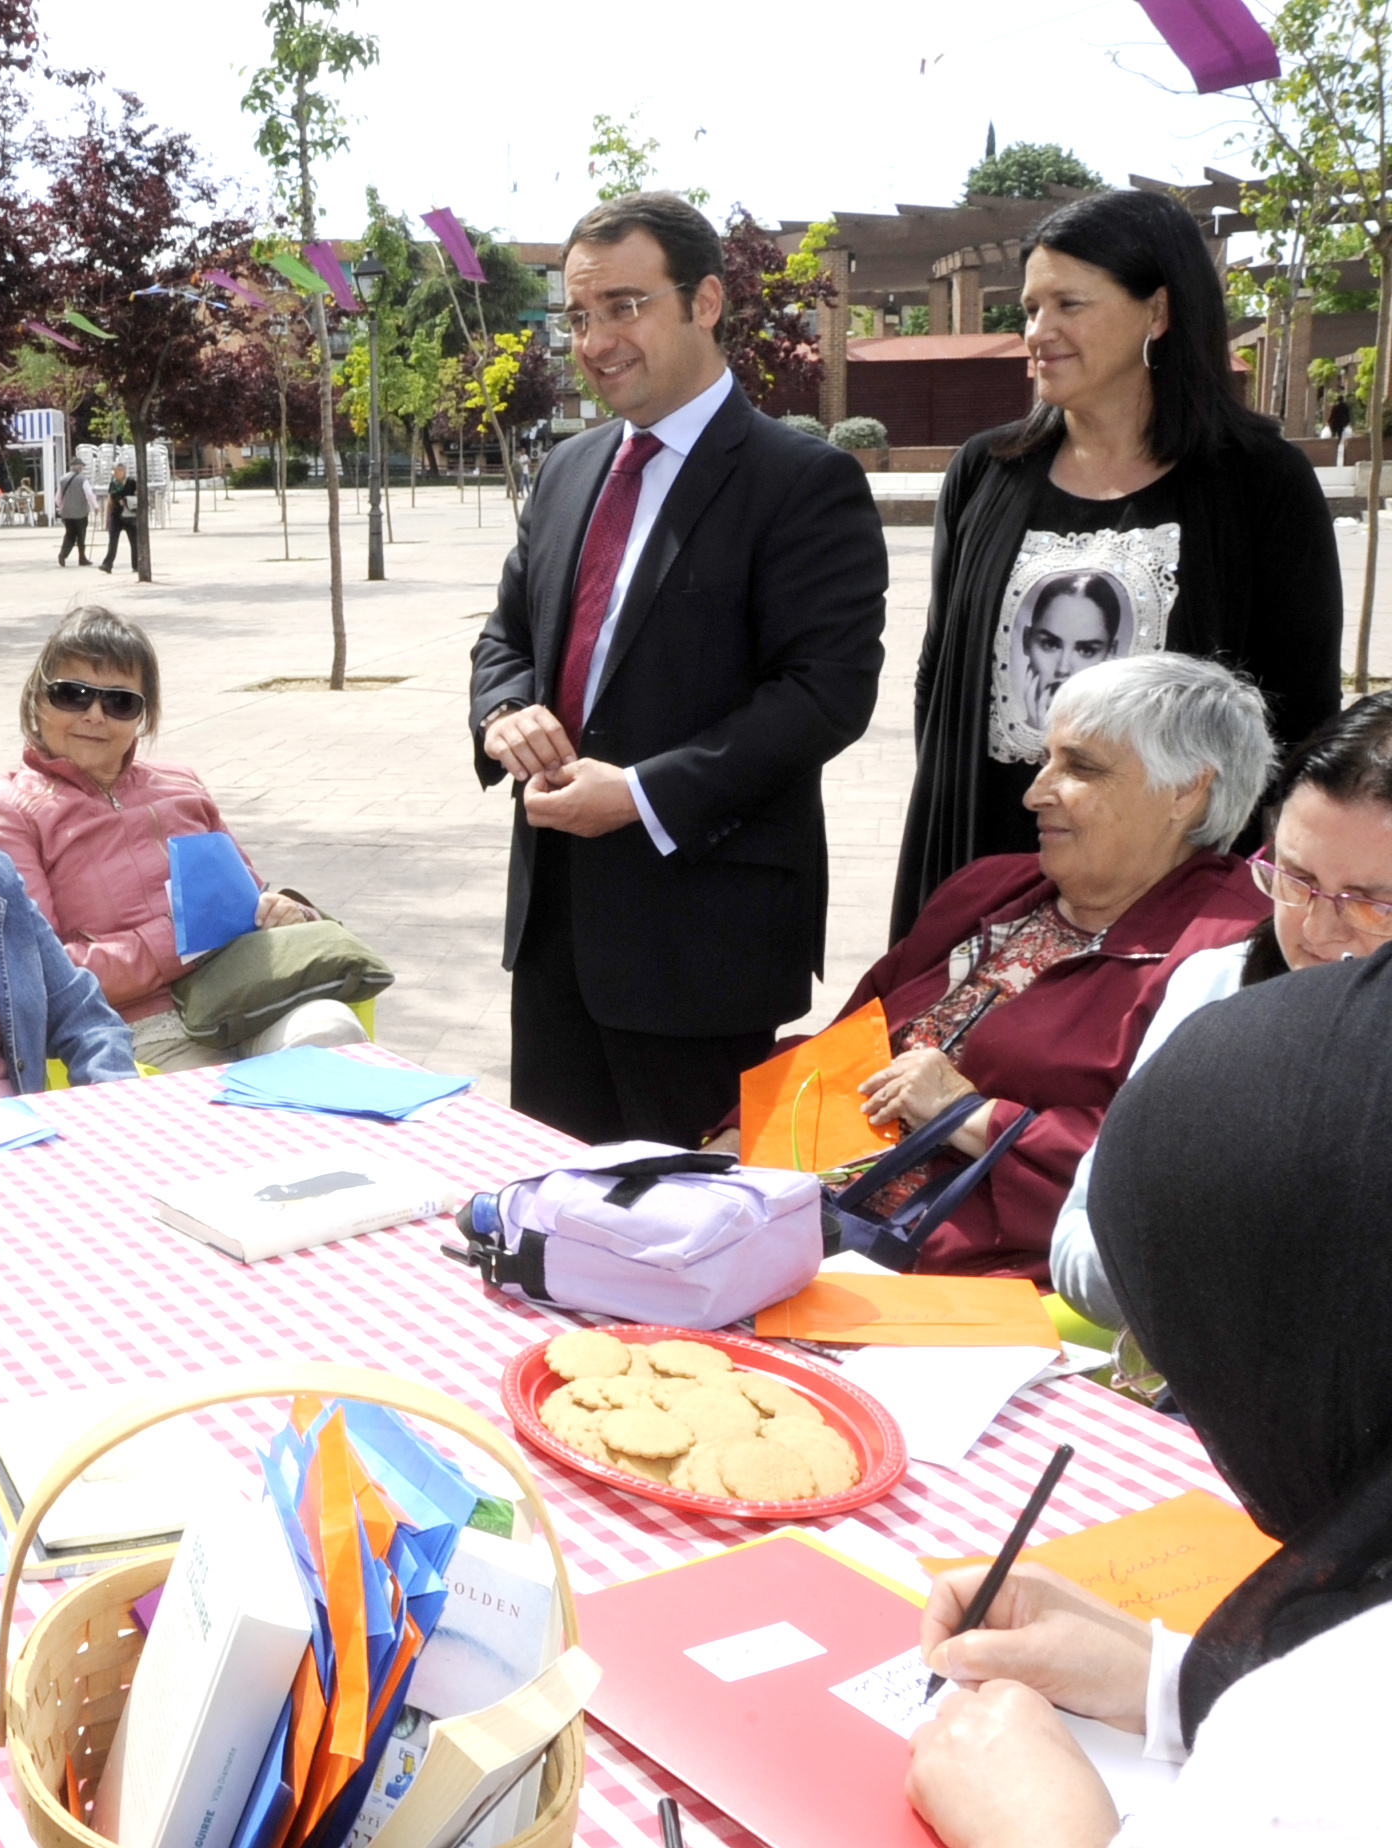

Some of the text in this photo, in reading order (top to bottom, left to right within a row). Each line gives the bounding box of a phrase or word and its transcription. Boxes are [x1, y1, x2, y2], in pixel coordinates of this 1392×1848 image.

[441, 1574, 521, 1618] GOLDEN
[194, 1748, 237, 1848] GUIRRE Villa Diamante
